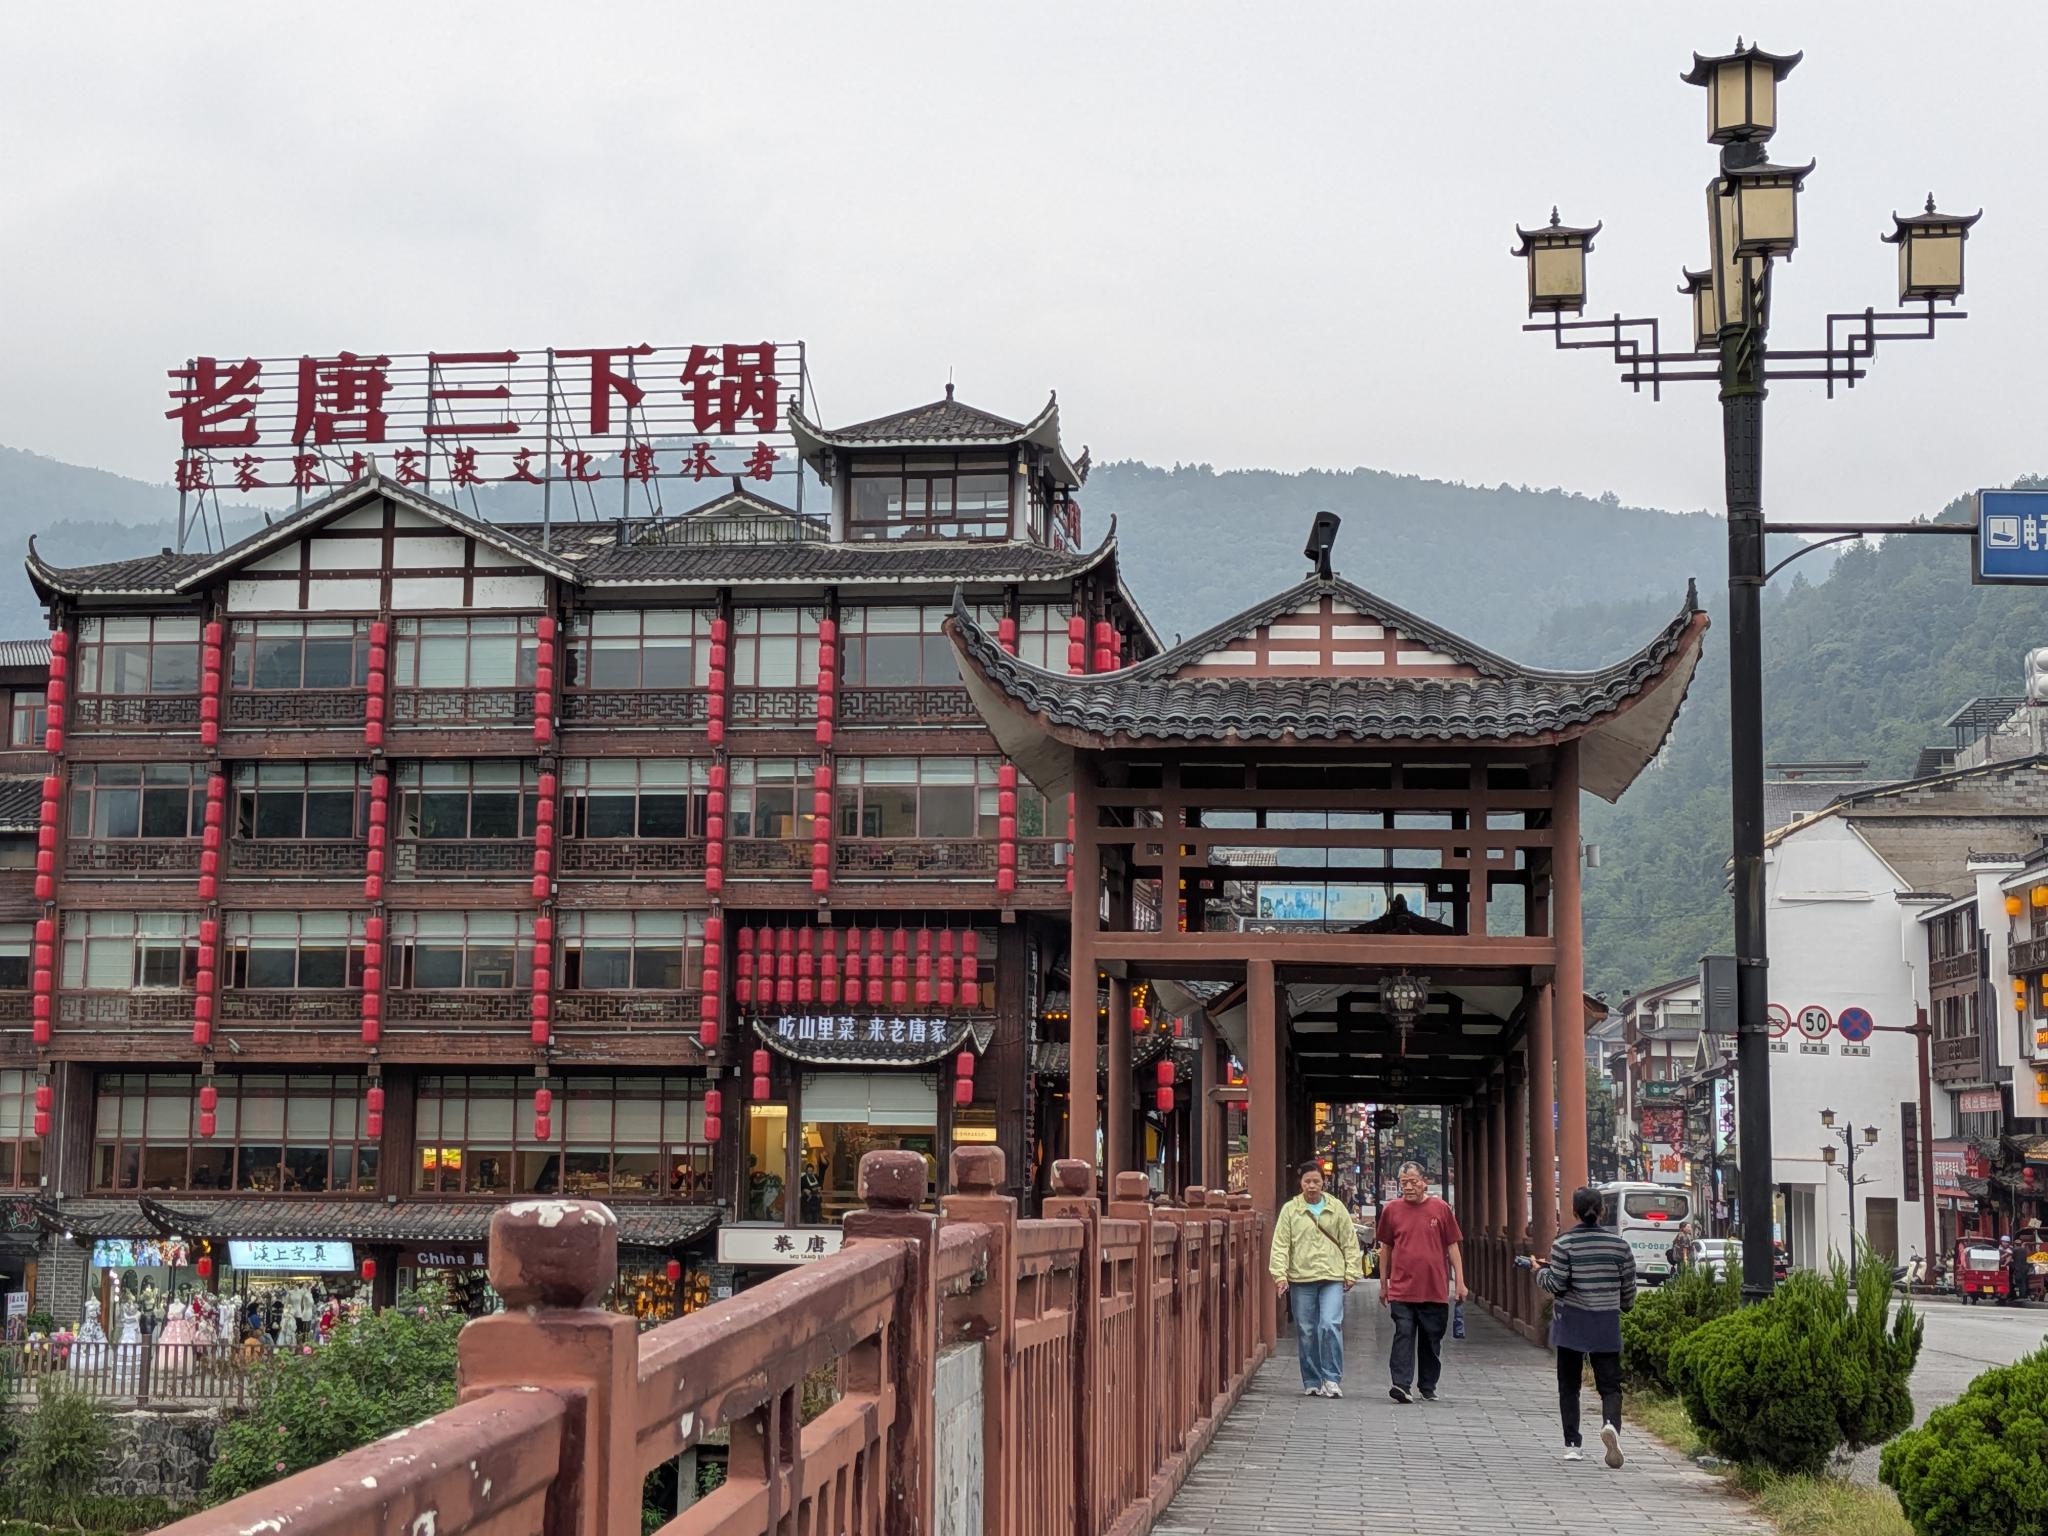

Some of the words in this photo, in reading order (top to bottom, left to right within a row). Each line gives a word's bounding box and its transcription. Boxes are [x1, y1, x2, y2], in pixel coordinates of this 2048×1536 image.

[165, 341, 779, 447] 老唐三下锅
[778, 1014, 856, 1041] 吃山里菜
[868, 1016, 948, 1043] 来老唐家
[1806, 1012, 1826, 1031] 50
[417, 1252, 466, 1265] China
